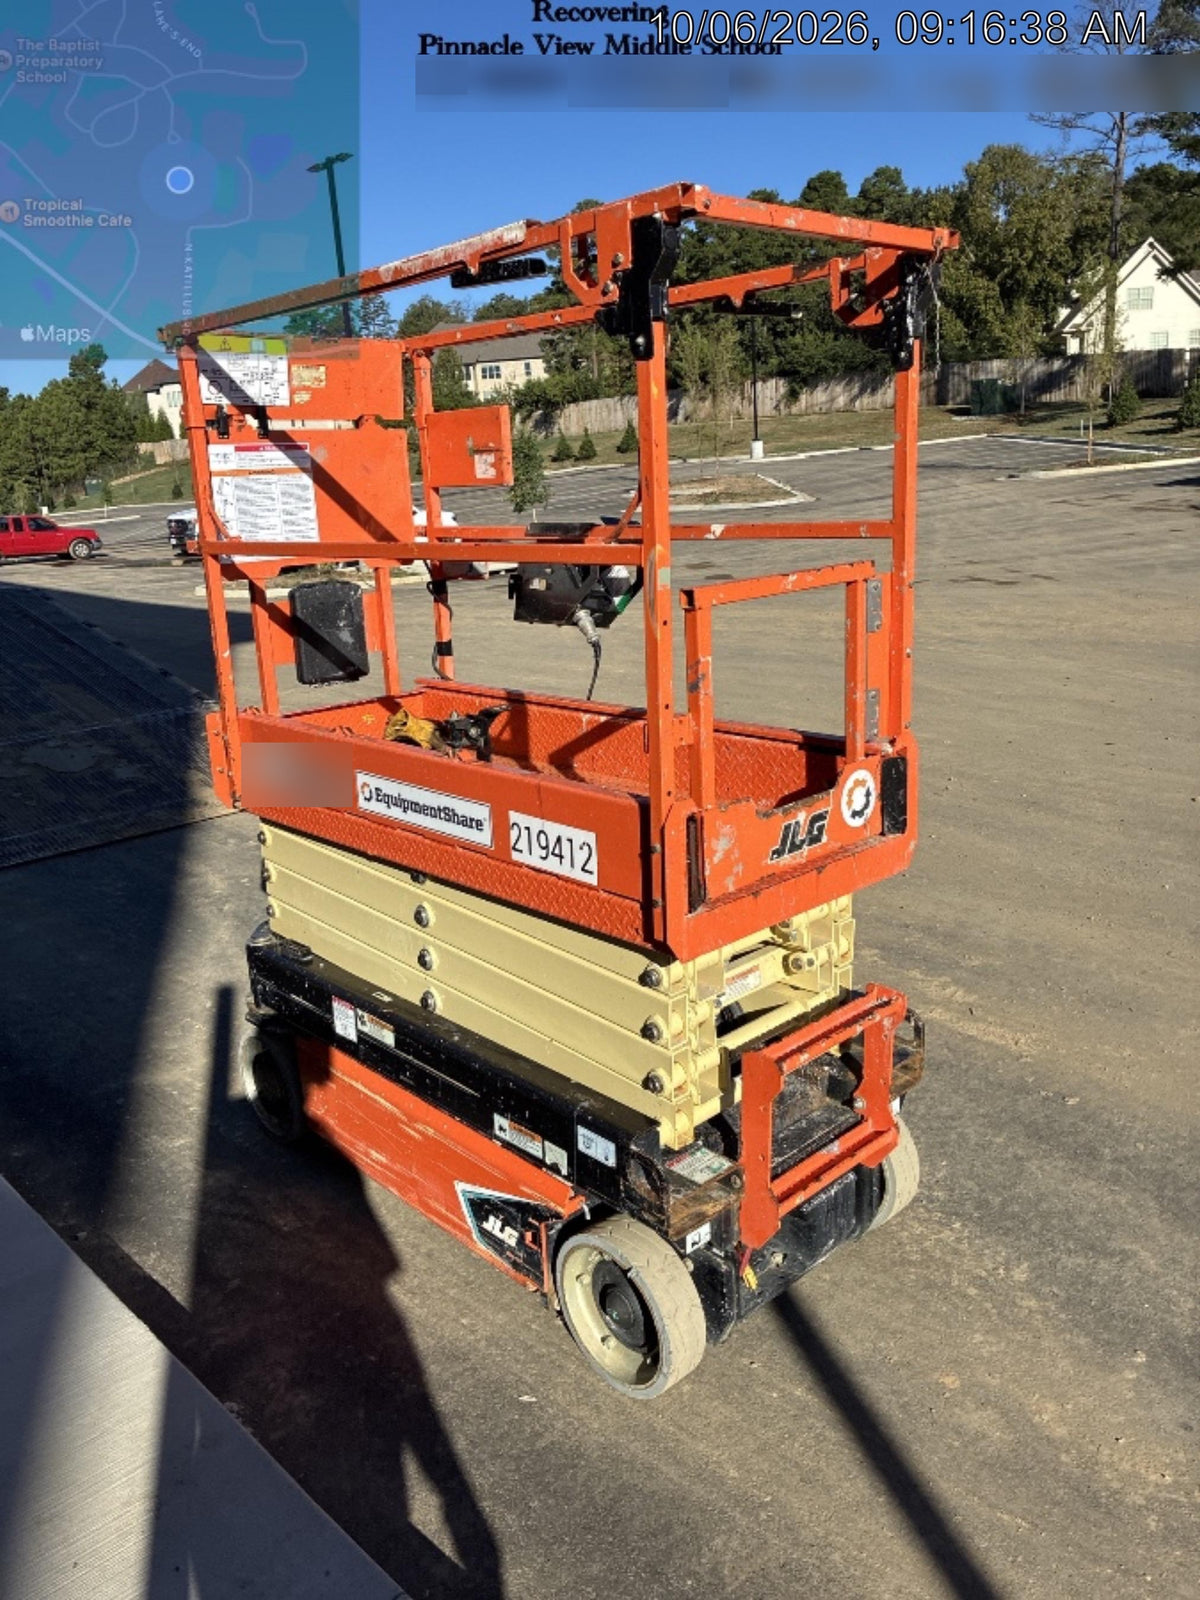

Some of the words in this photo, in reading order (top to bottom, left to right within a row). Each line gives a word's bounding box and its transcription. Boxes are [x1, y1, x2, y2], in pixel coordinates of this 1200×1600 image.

[373, 786, 485, 833] EquipmentShare
[510, 822, 595, 876] 219412
[769, 808, 831, 863] JLG
[480, 1214, 520, 1247] JLG
